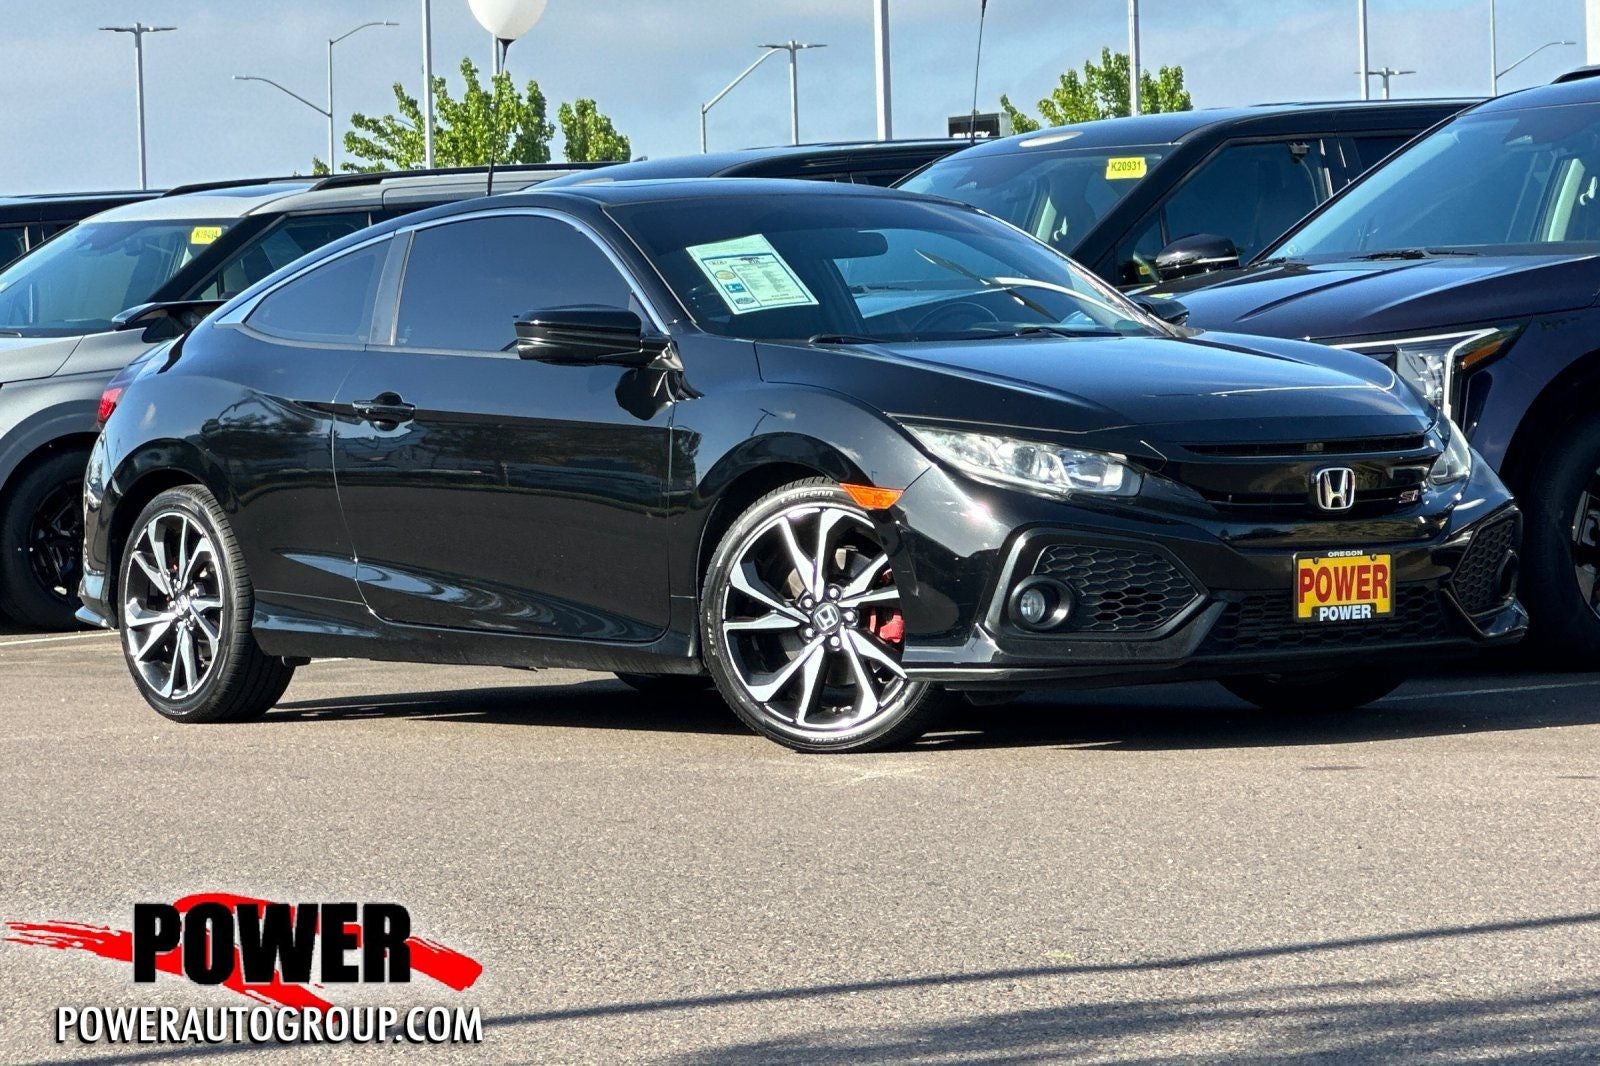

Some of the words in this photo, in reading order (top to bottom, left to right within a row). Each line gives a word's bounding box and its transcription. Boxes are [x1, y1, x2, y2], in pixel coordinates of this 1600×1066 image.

[1111, 161, 1141, 171] K20931
[1327, 550, 1363, 558] OREGON
[1299, 563, 1388, 604] POWER
[1319, 605, 1371, 622] POWER
